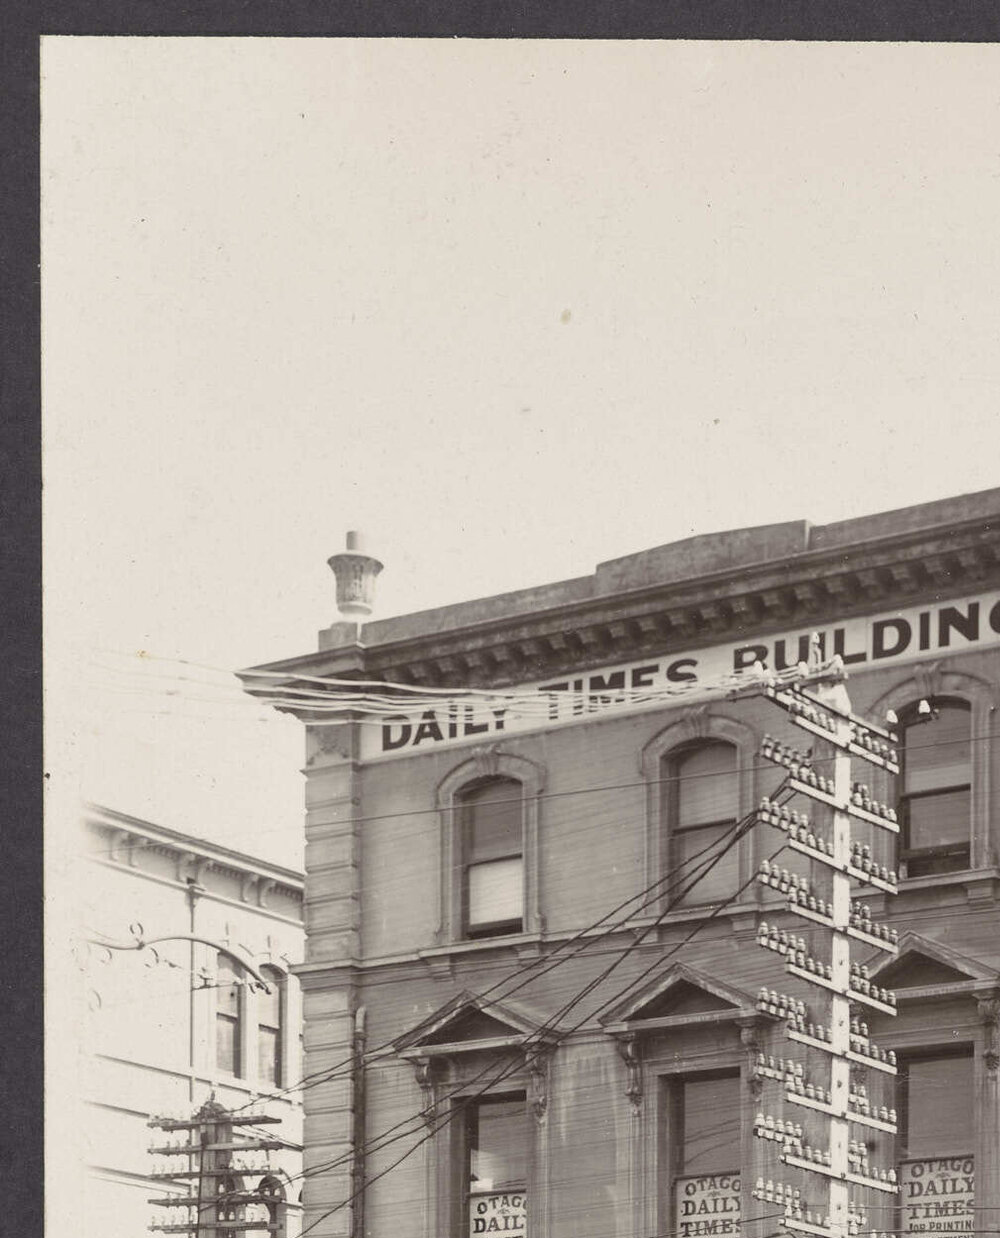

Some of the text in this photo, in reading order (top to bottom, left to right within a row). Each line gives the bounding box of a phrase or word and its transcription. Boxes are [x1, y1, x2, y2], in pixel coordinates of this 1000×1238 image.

[382, 701, 507, 751] DAILY
[538, 659, 698, 719] TIMES
[911, 1160, 975, 1178] OTAGO
[685, 1176, 741, 1196] OTAGO
[907, 1177, 975, 1198] DAILY
[907, 1199, 975, 1220] TIMES
[473, 1214, 526, 1233] DAIL
[906, 1223, 927, 1235] JOB
